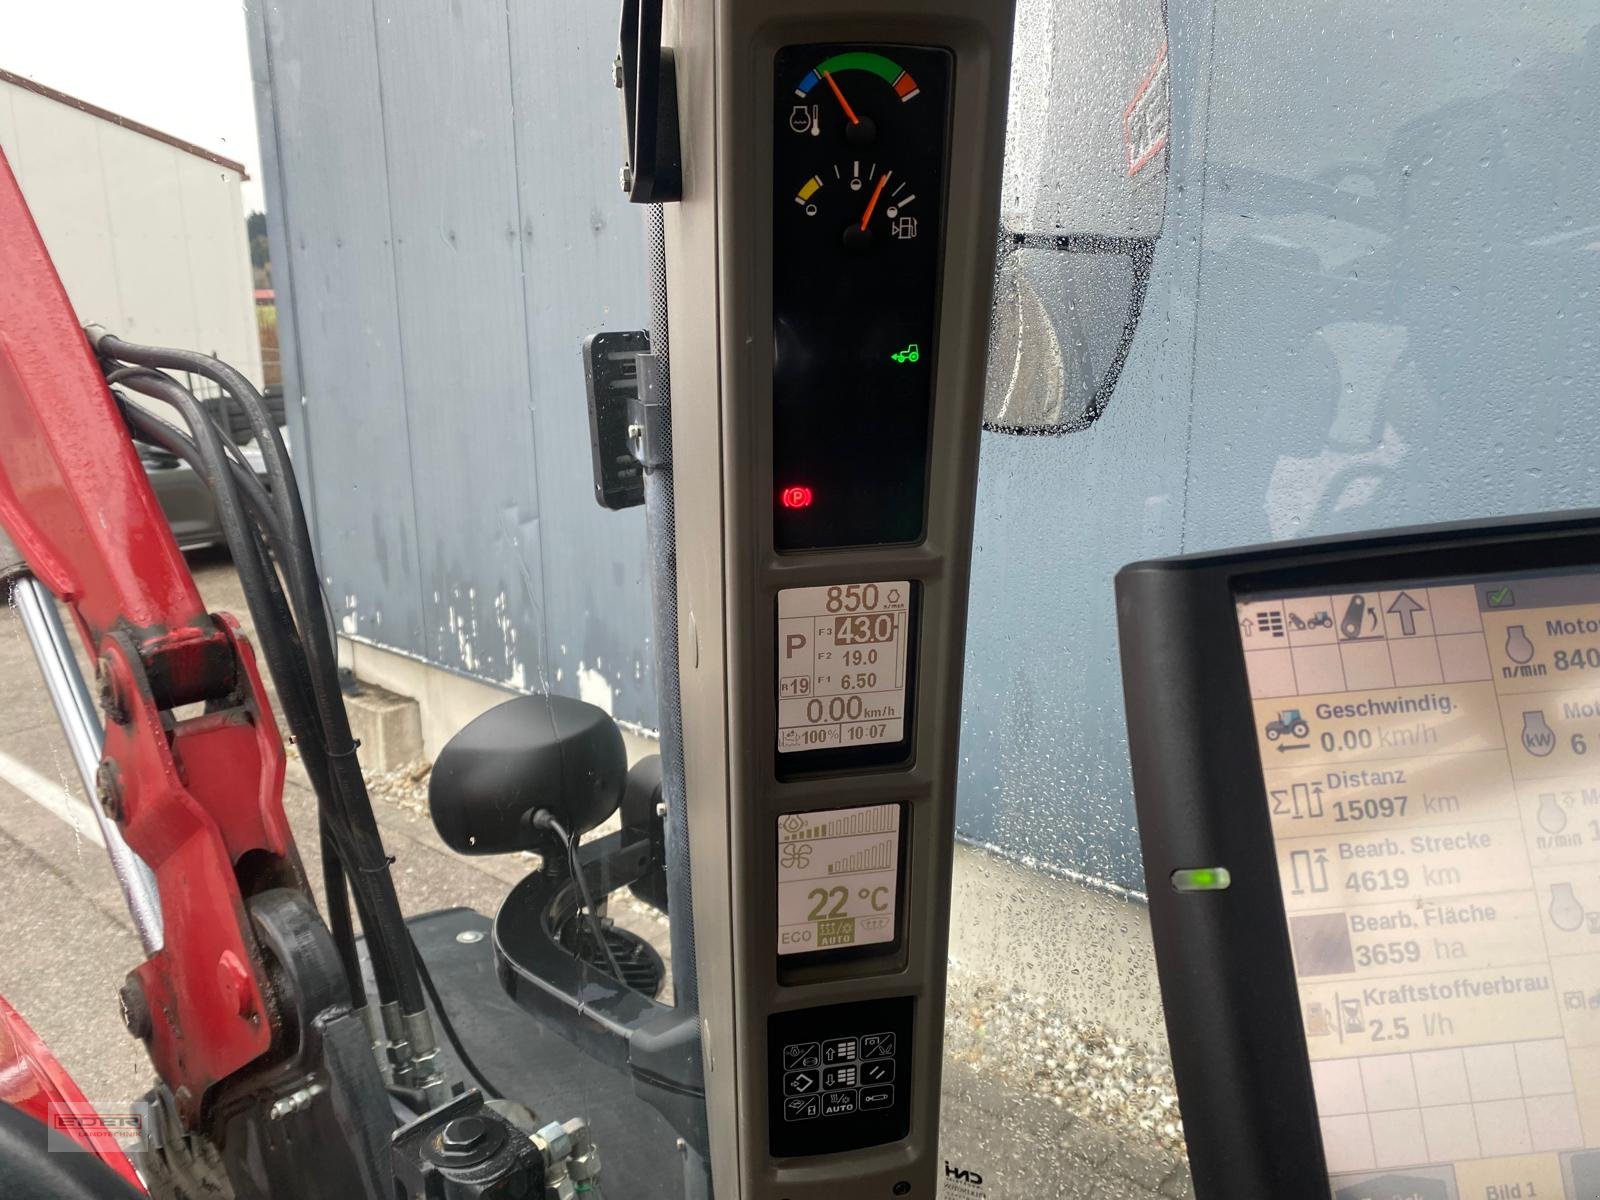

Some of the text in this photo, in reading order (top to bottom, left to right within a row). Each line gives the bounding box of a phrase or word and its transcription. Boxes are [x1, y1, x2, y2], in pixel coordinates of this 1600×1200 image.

[826, 584, 879, 613] 850
[818, 614, 892, 644] F3 43.0
[1546, 618, 1600, 637] Moto
[785, 634, 807, 659] P
[817, 649, 878, 667] F2 19.0
[1502, 647, 1600, 680] n/min 840
[817, 672, 877, 690] F1 6.50
[806, 695, 895, 724] 0.00 km/h
[1315, 693, 1458, 722] Geschwindig.
[848, 724, 887, 741] 10:07
[1320, 725, 1439, 752] 0.00 km/h
[1526, 733, 1551, 747] kW
[1571, 733, 1587, 755] 6
[1326, 768, 1406, 791] Distanz
[1333, 793, 1460, 823] 15097 km
[1339, 831, 1491, 860] Bearb. Strecke
[1536, 832, 1583, 849] n/min
[1345, 864, 1461, 893] 4619 km
[807, 885, 890, 921] 22 °C
[1350, 901, 1496, 933] Bearb. Fläche
[781, 929, 812, 945] ECO
[822, 935, 850, 946] AUTO
[1356, 937, 1468, 967] 3659 ha
[1363, 975, 1550, 1007] Kraftstoffverbrau
[1369, 1013, 1454, 1042] 2.5 l/h
[826, 1103, 853, 1114] AUTO
[1485, 1181, 1537, 1200] Bild 1
